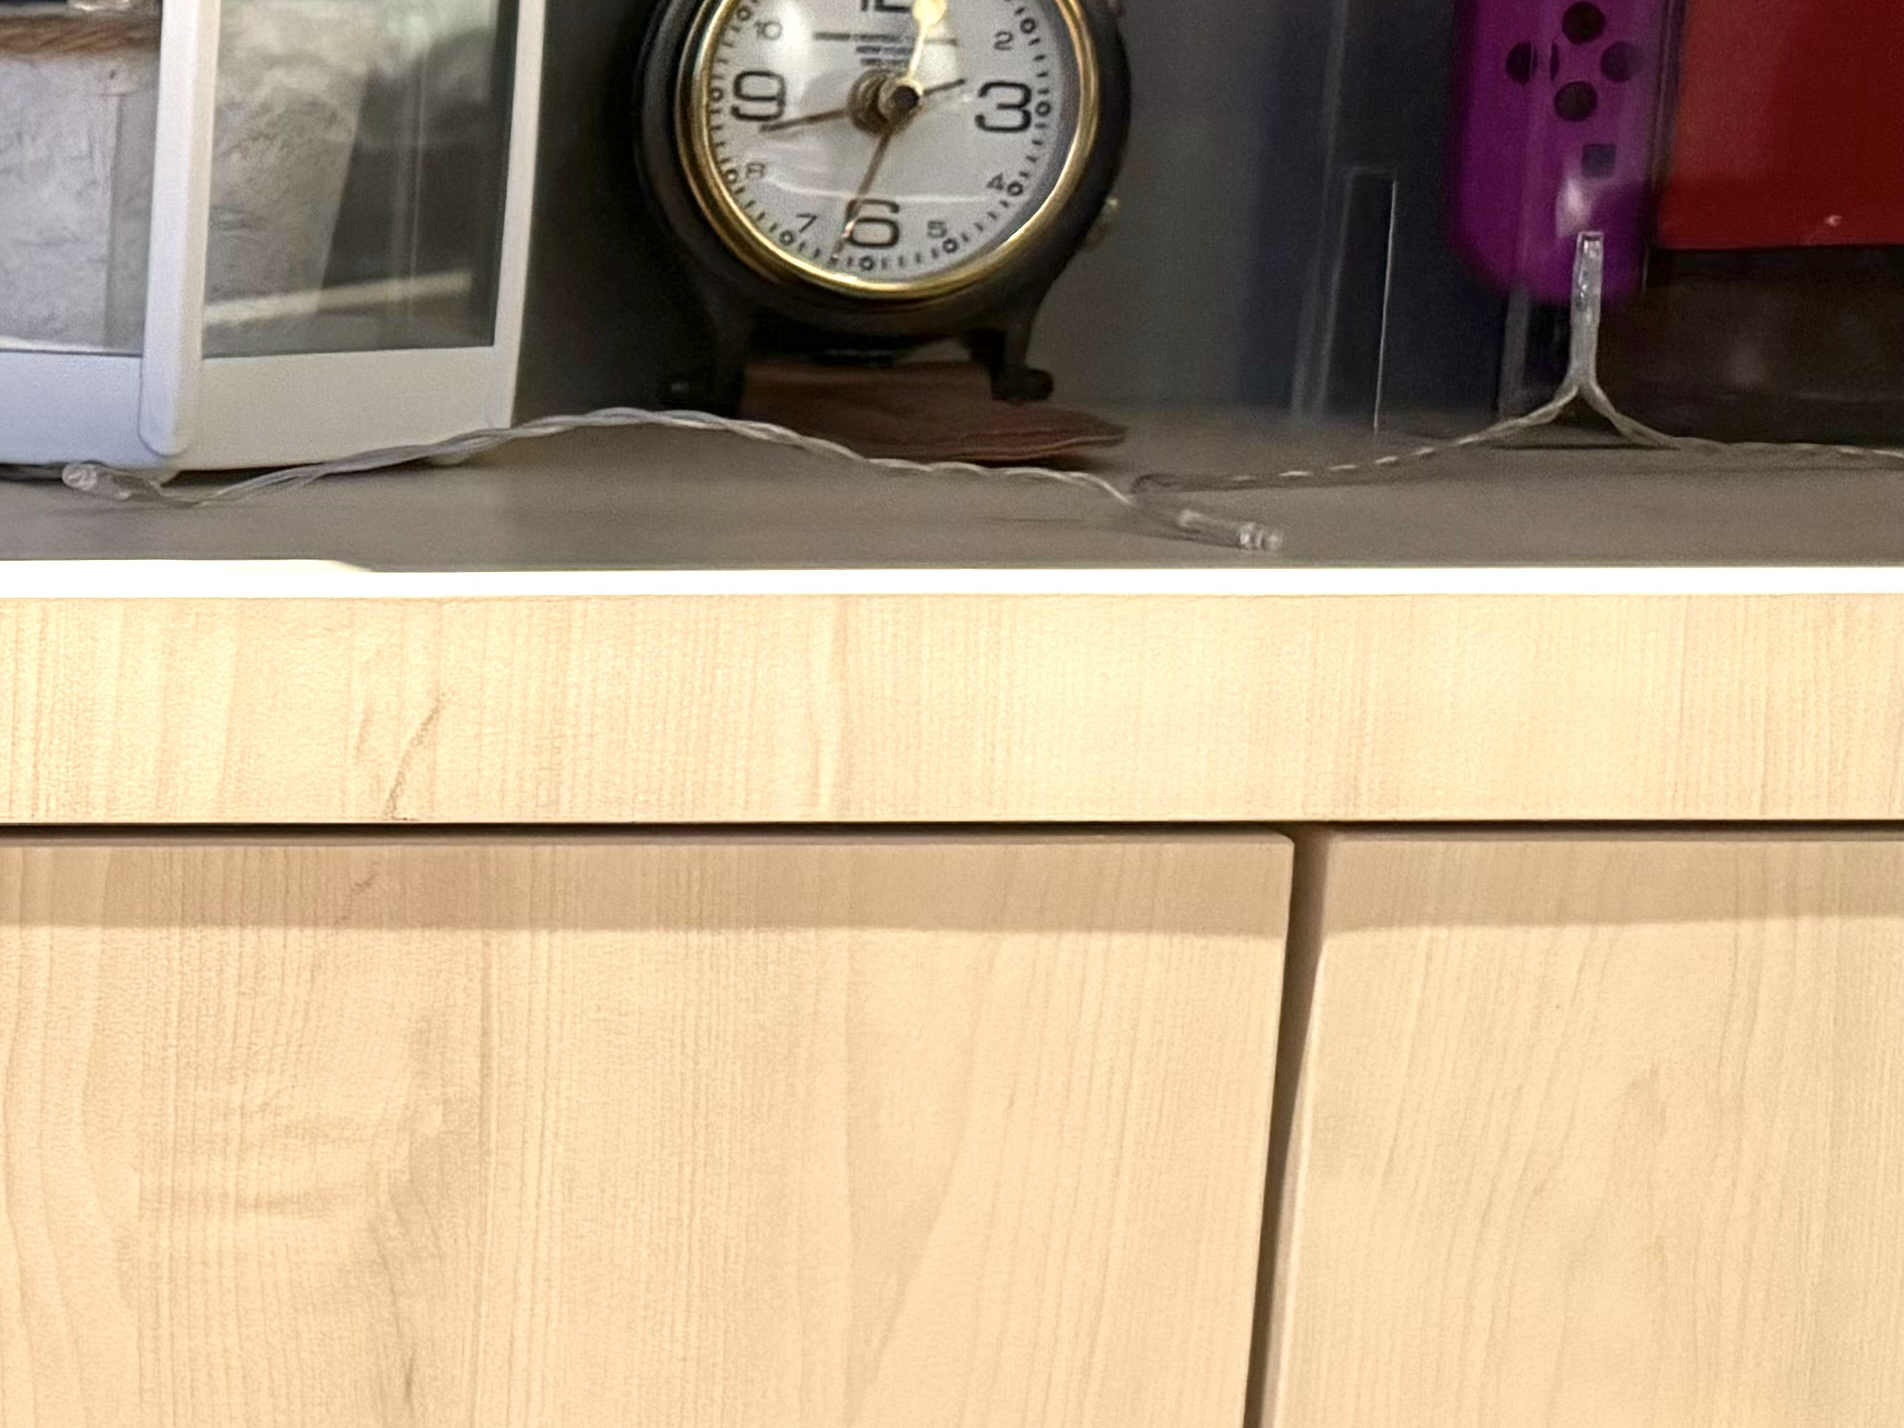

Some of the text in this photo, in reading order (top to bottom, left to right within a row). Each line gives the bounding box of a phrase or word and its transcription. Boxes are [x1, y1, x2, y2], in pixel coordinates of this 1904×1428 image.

[754, 21, 783, 40] 10
[994, 31, 1013, 51] 2
[730, 71, 786, 121] 9
[975, 81, 1032, 133] 3
[796, 213, 818, 233] 7
[845, 198, 900, 249] 6
[927, 220, 947, 239] 5
